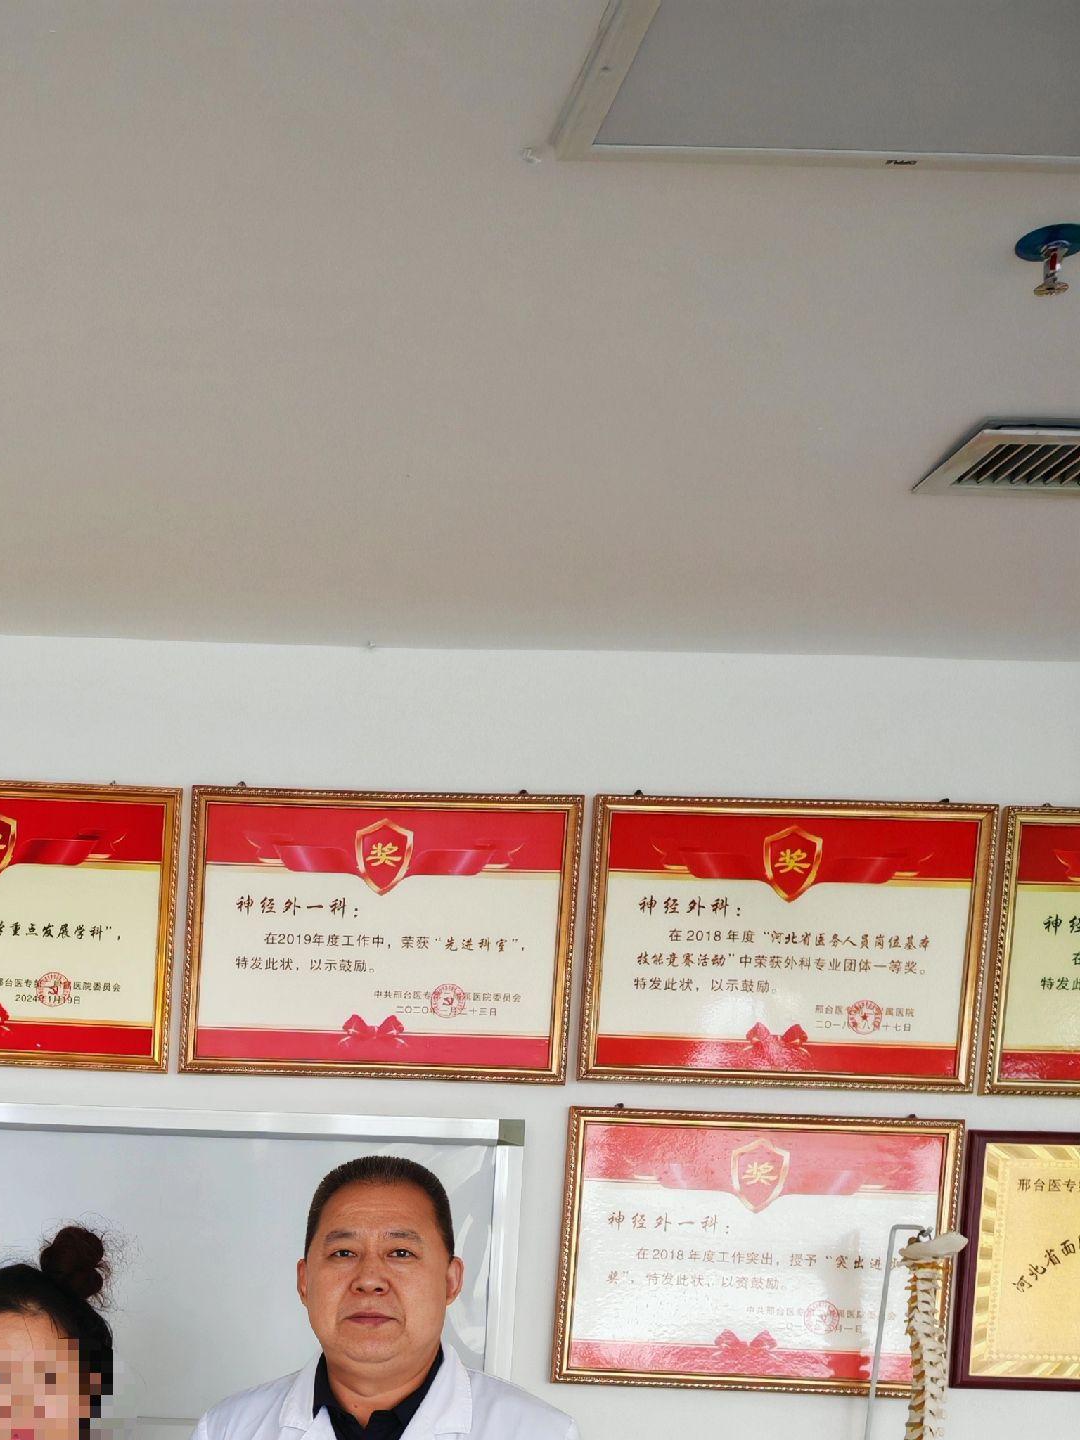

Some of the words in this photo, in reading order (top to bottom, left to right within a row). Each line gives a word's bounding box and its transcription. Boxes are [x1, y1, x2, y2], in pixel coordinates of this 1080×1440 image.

[365, 843, 402, 868] 奖
[774, 849, 812, 875] 奖
[235, 895, 361, 919] 神经外一科：
[638, 895, 742, 917] 神经外科：
[234, 956, 376, 974] 特发此状，以示鼓励。
[633, 977, 778, 994] 特发此状，以示鼓励。
[741, 1160, 778, 1186] 奖
[1017, 1178, 1080, 1192] 邢台医专
[607, 1210, 730, 1234] 神经外一科：
[1012, 1235, 1080, 1293] 河北省西
